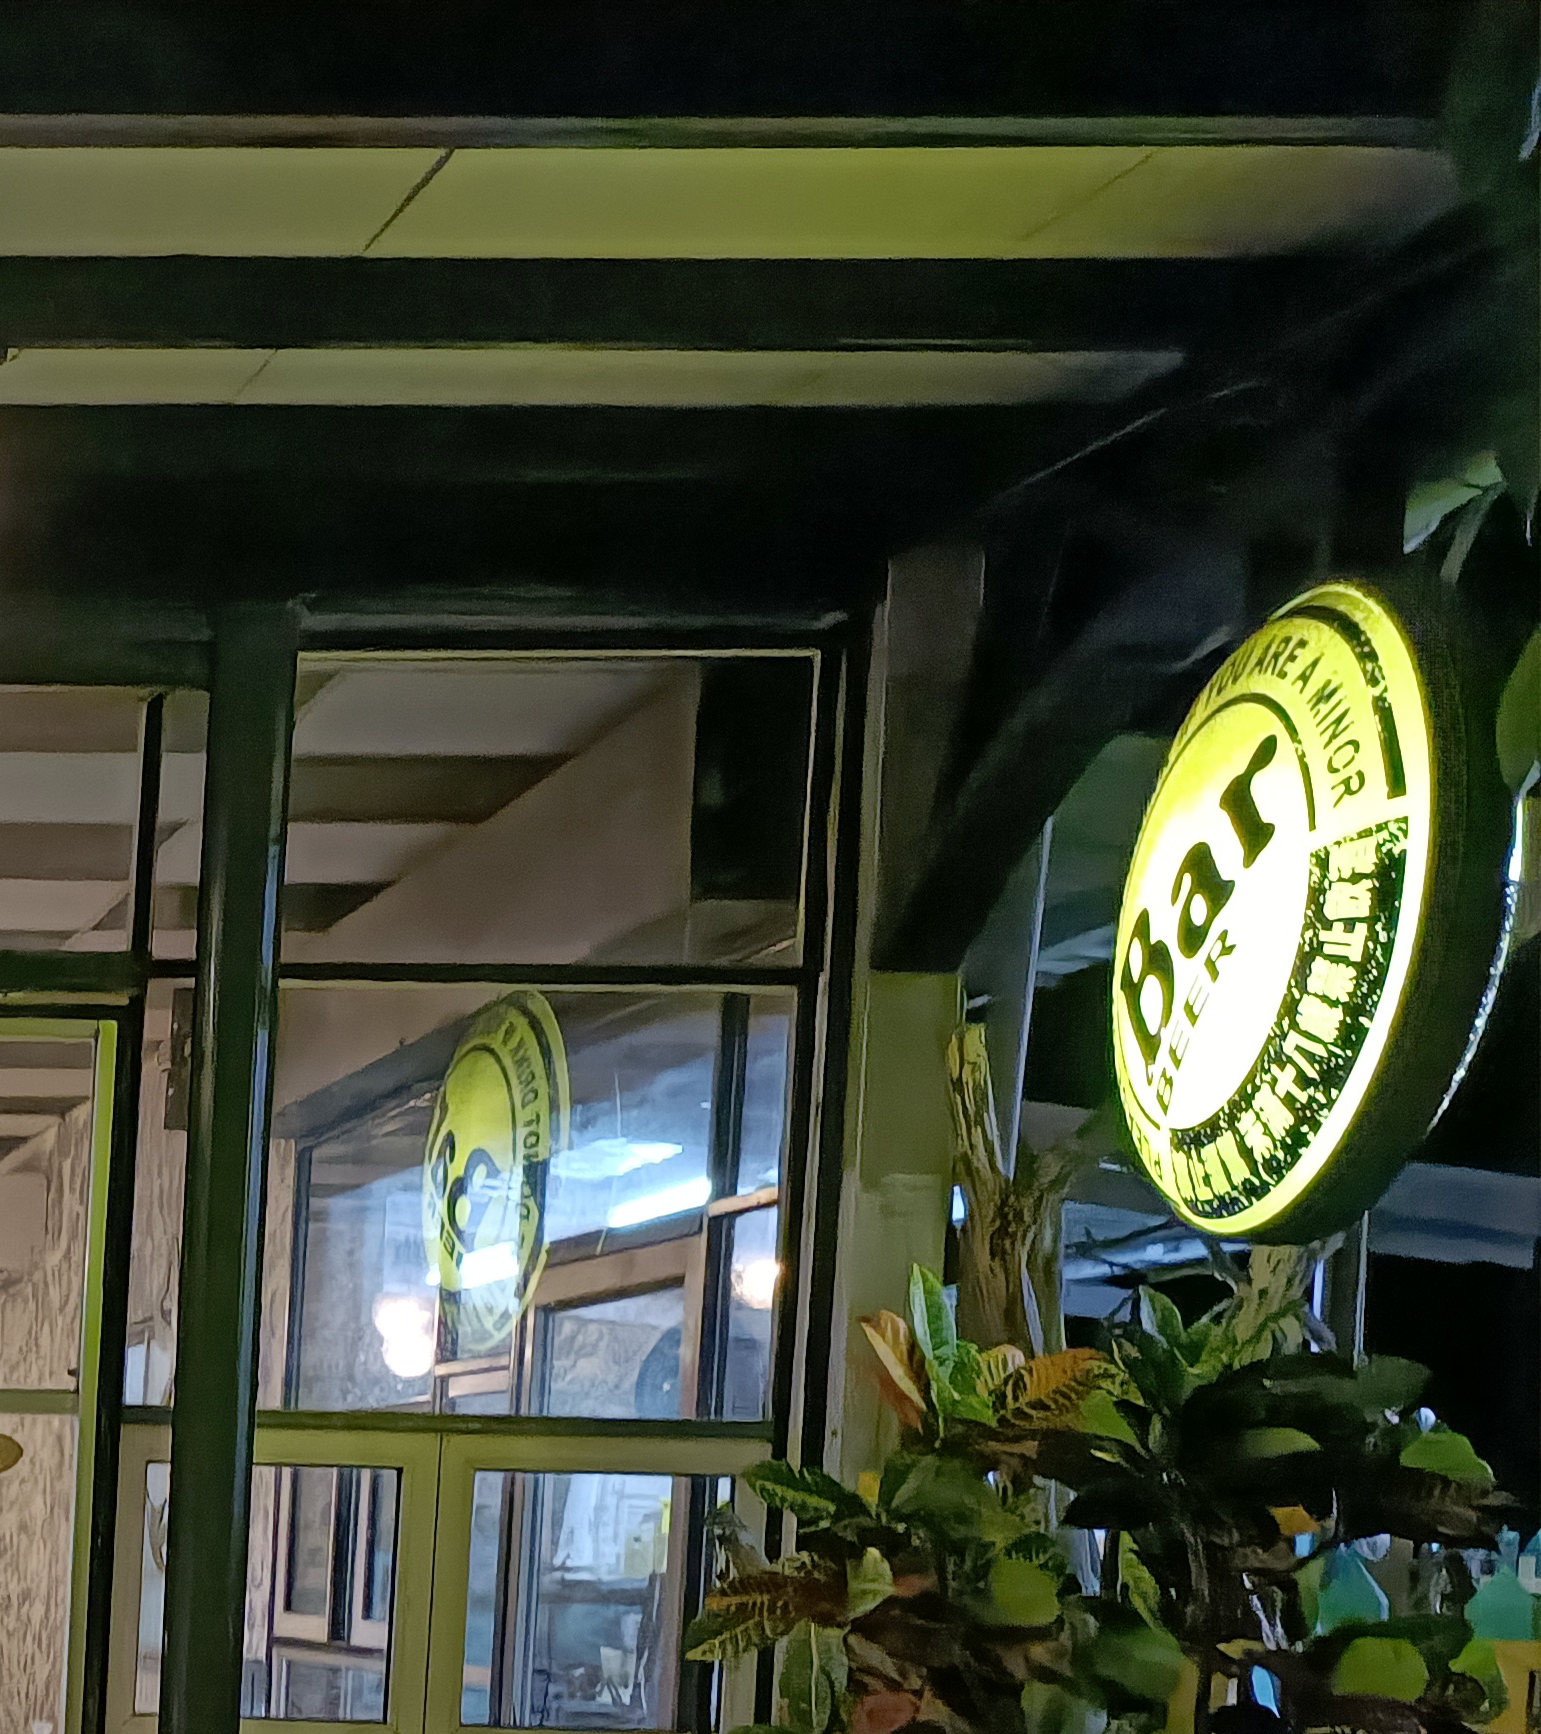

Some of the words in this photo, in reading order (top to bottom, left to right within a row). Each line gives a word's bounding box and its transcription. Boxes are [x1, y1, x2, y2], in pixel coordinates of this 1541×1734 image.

[1247, 634, 1309, 681] ARE
[1291, 652, 1325, 695] A
[1306, 678, 1366, 809] MINOR
[1120, 733, 1278, 1087] Bar
[1156, 929, 1237, 1117] BEER
